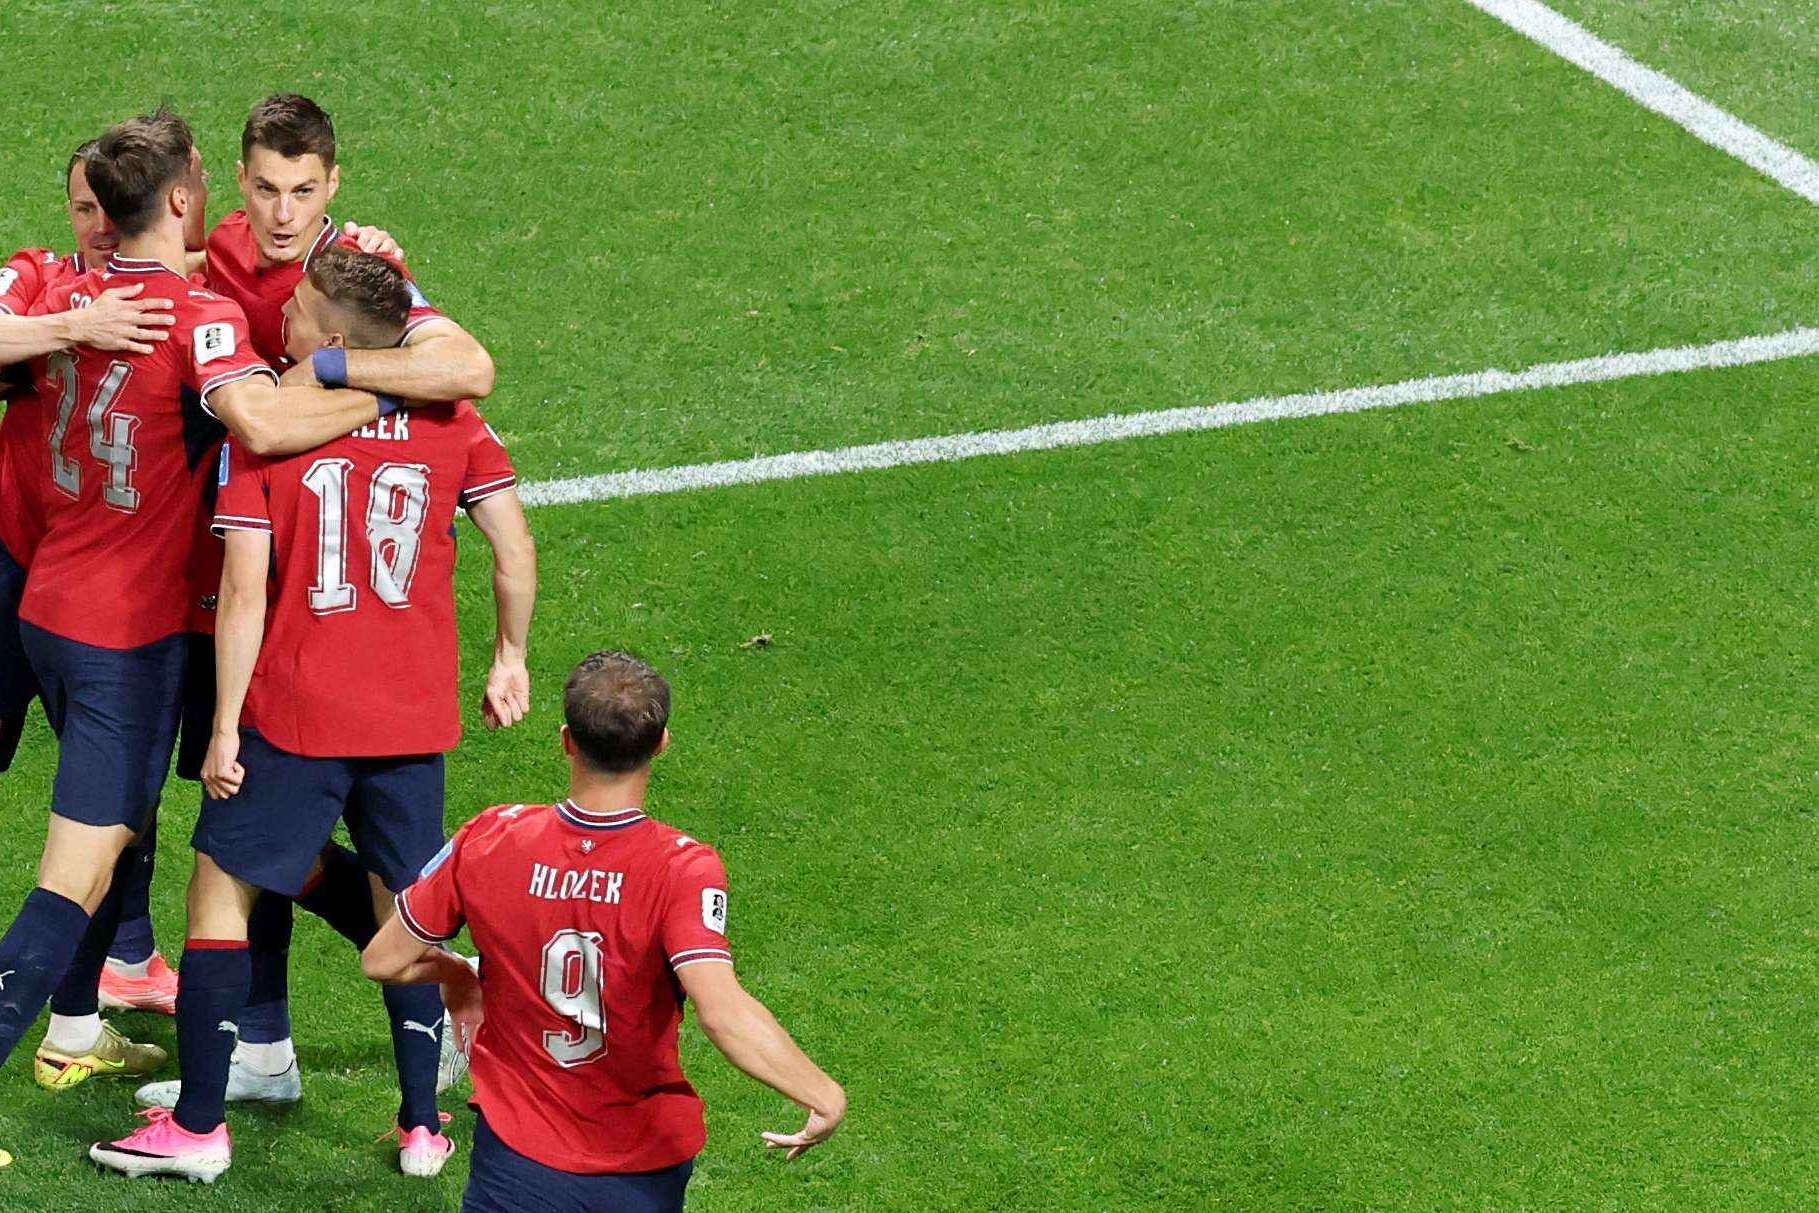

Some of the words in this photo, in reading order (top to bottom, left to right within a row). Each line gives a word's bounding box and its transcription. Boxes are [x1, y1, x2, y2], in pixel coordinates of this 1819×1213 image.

[46, 350, 142, 514] 24
[302, 457, 432, 616] 18
[540, 928, 608, 1068] 9
